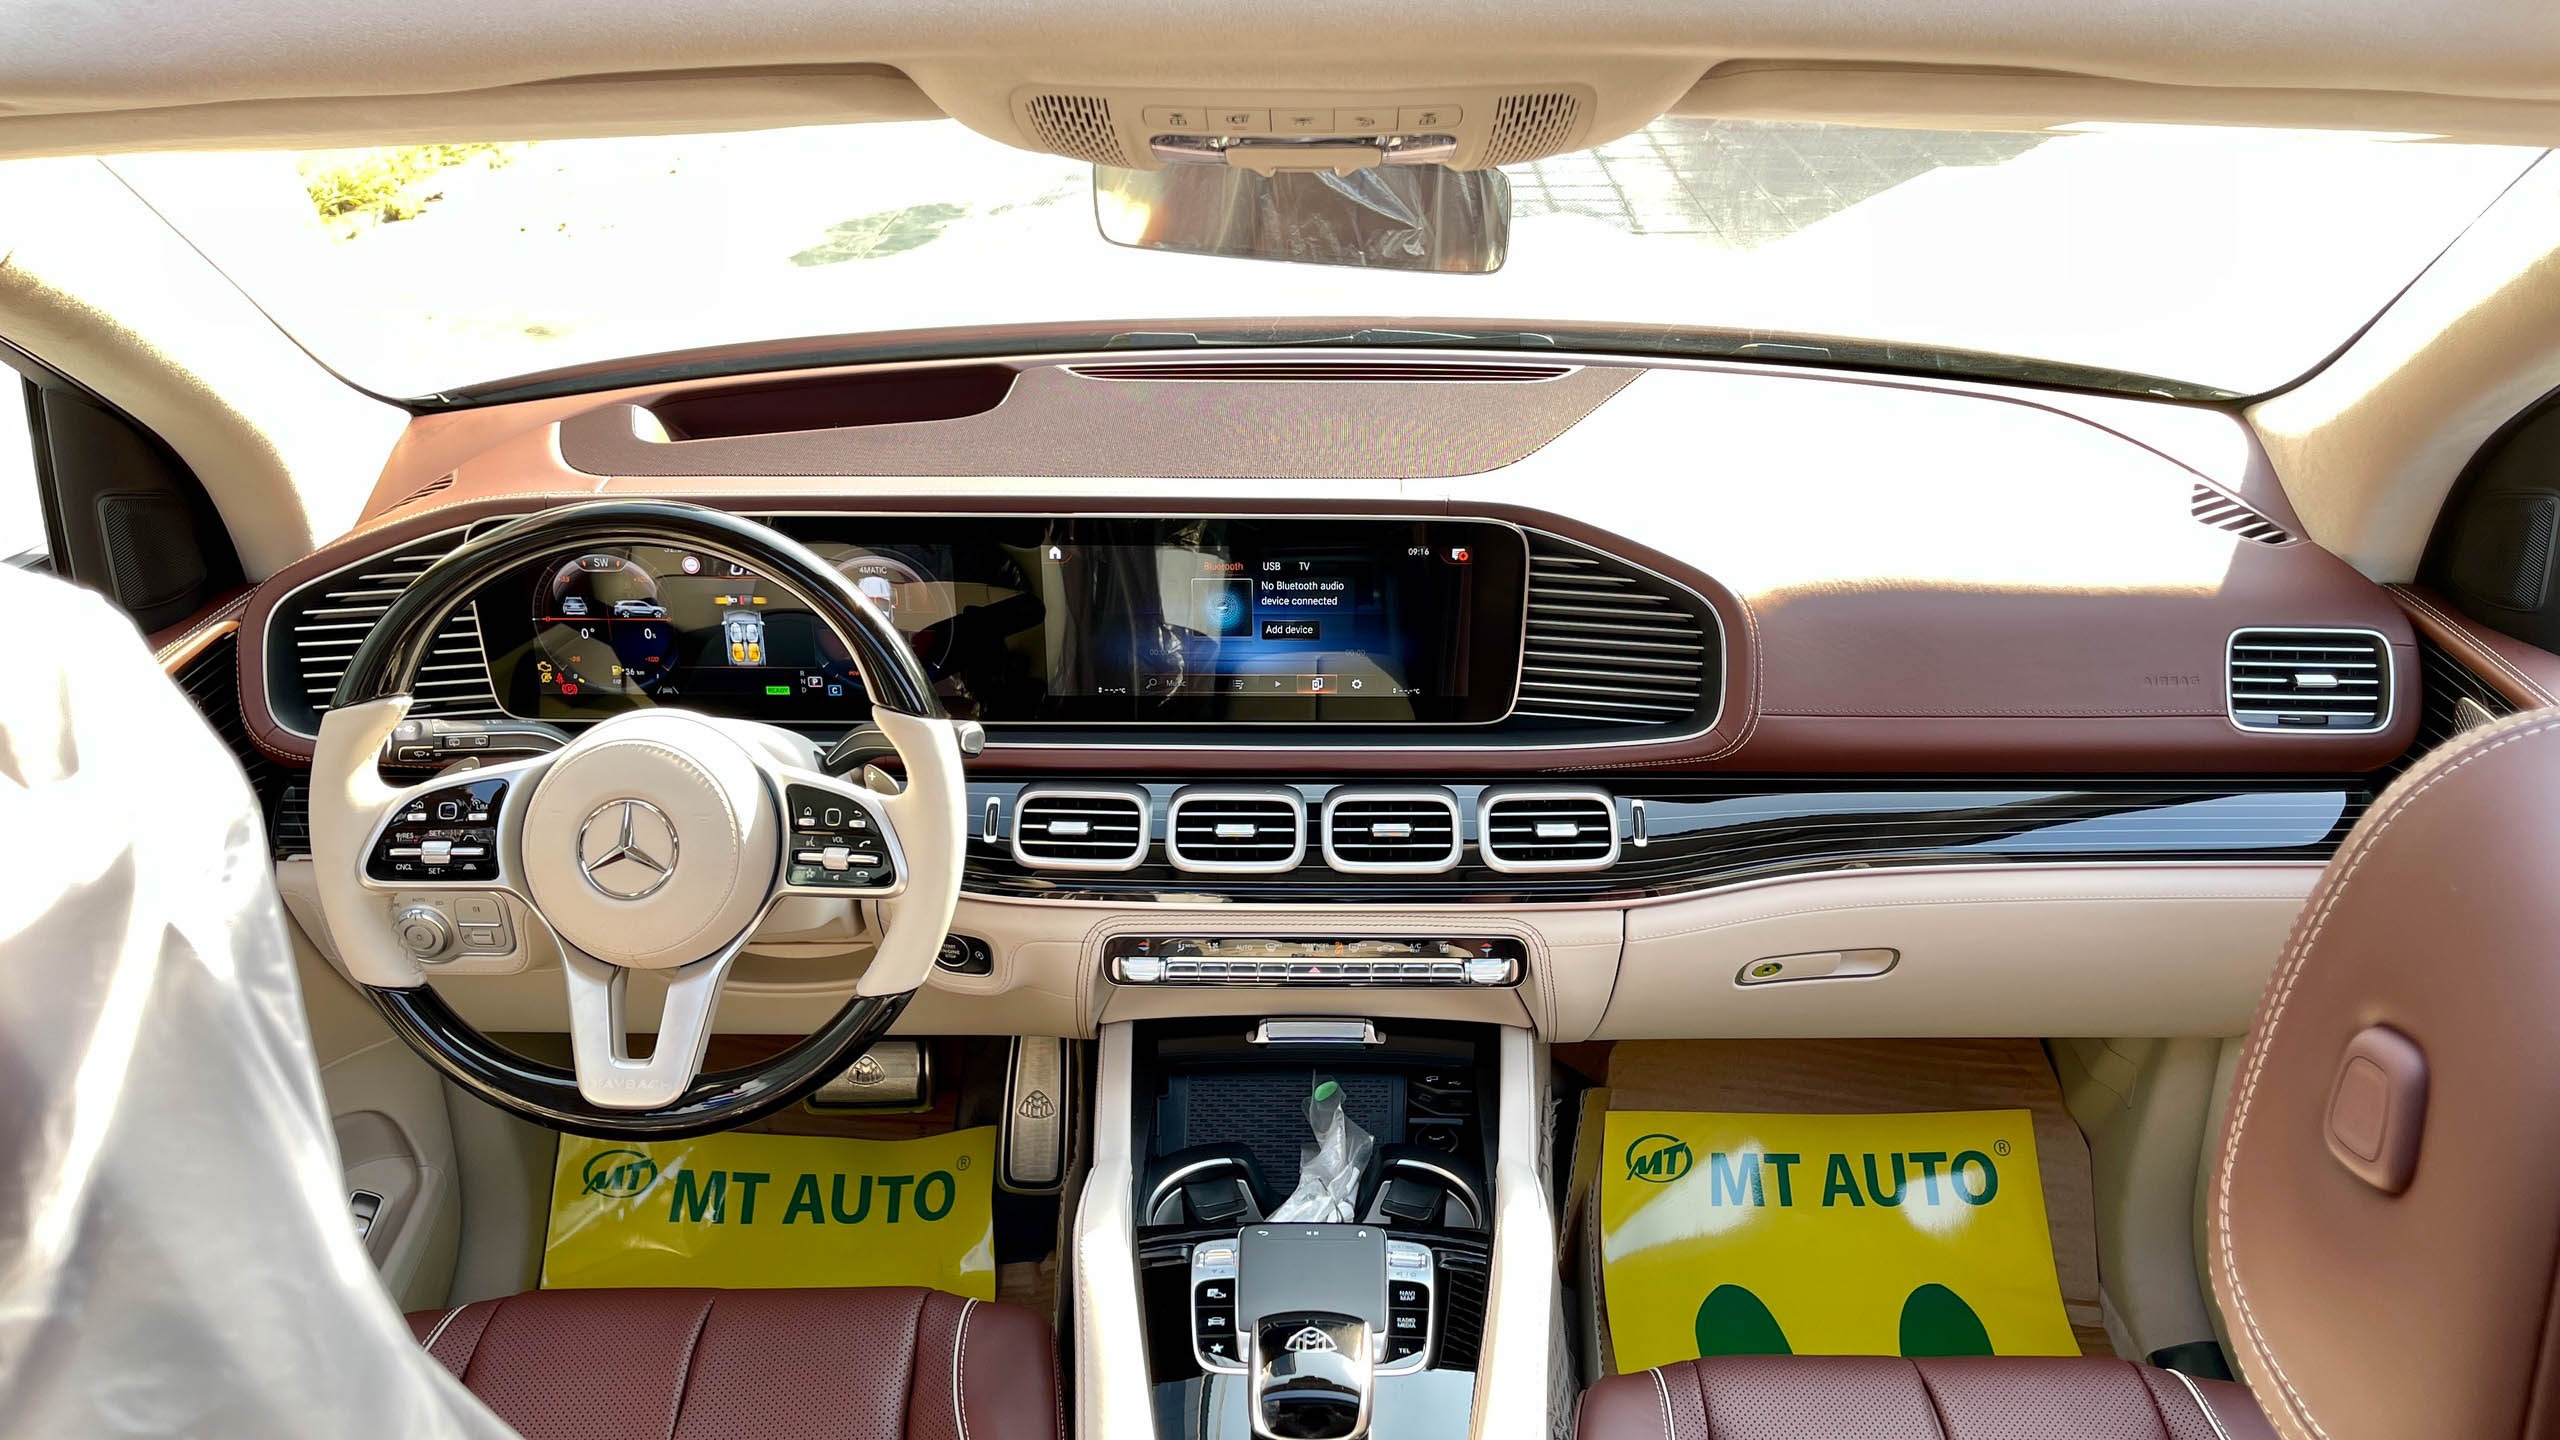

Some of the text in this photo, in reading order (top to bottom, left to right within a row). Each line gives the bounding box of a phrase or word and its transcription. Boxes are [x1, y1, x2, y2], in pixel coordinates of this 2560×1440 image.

[1408, 548, 1430, 556] 09:16
[593, 558, 609, 567] SW
[1203, 561, 1244, 571] Bluetooth
[1262, 561, 1281, 571] USB
[1299, 561, 1311, 571] TV
[859, 566, 888, 575] 4MATIC
[1261, 580, 1345, 591] No Bluetooth audio
[1261, 596, 1338, 606] device connected
[1265, 624, 1314, 634] Add device
[625, 668, 635, 676] 36
[2144, 674, 2201, 687] AIRBAG
[832, 836, 844, 844] VOL
[395, 863, 413, 871] CNCL
[1236, 944, 1253, 952] AUTO
[1710, 1151, 1800, 1207] MT
[1822, 1150, 1998, 1207] AUTO
[668, 1169, 771, 1225] MT
[782, 1169, 956, 1225] AUTO
